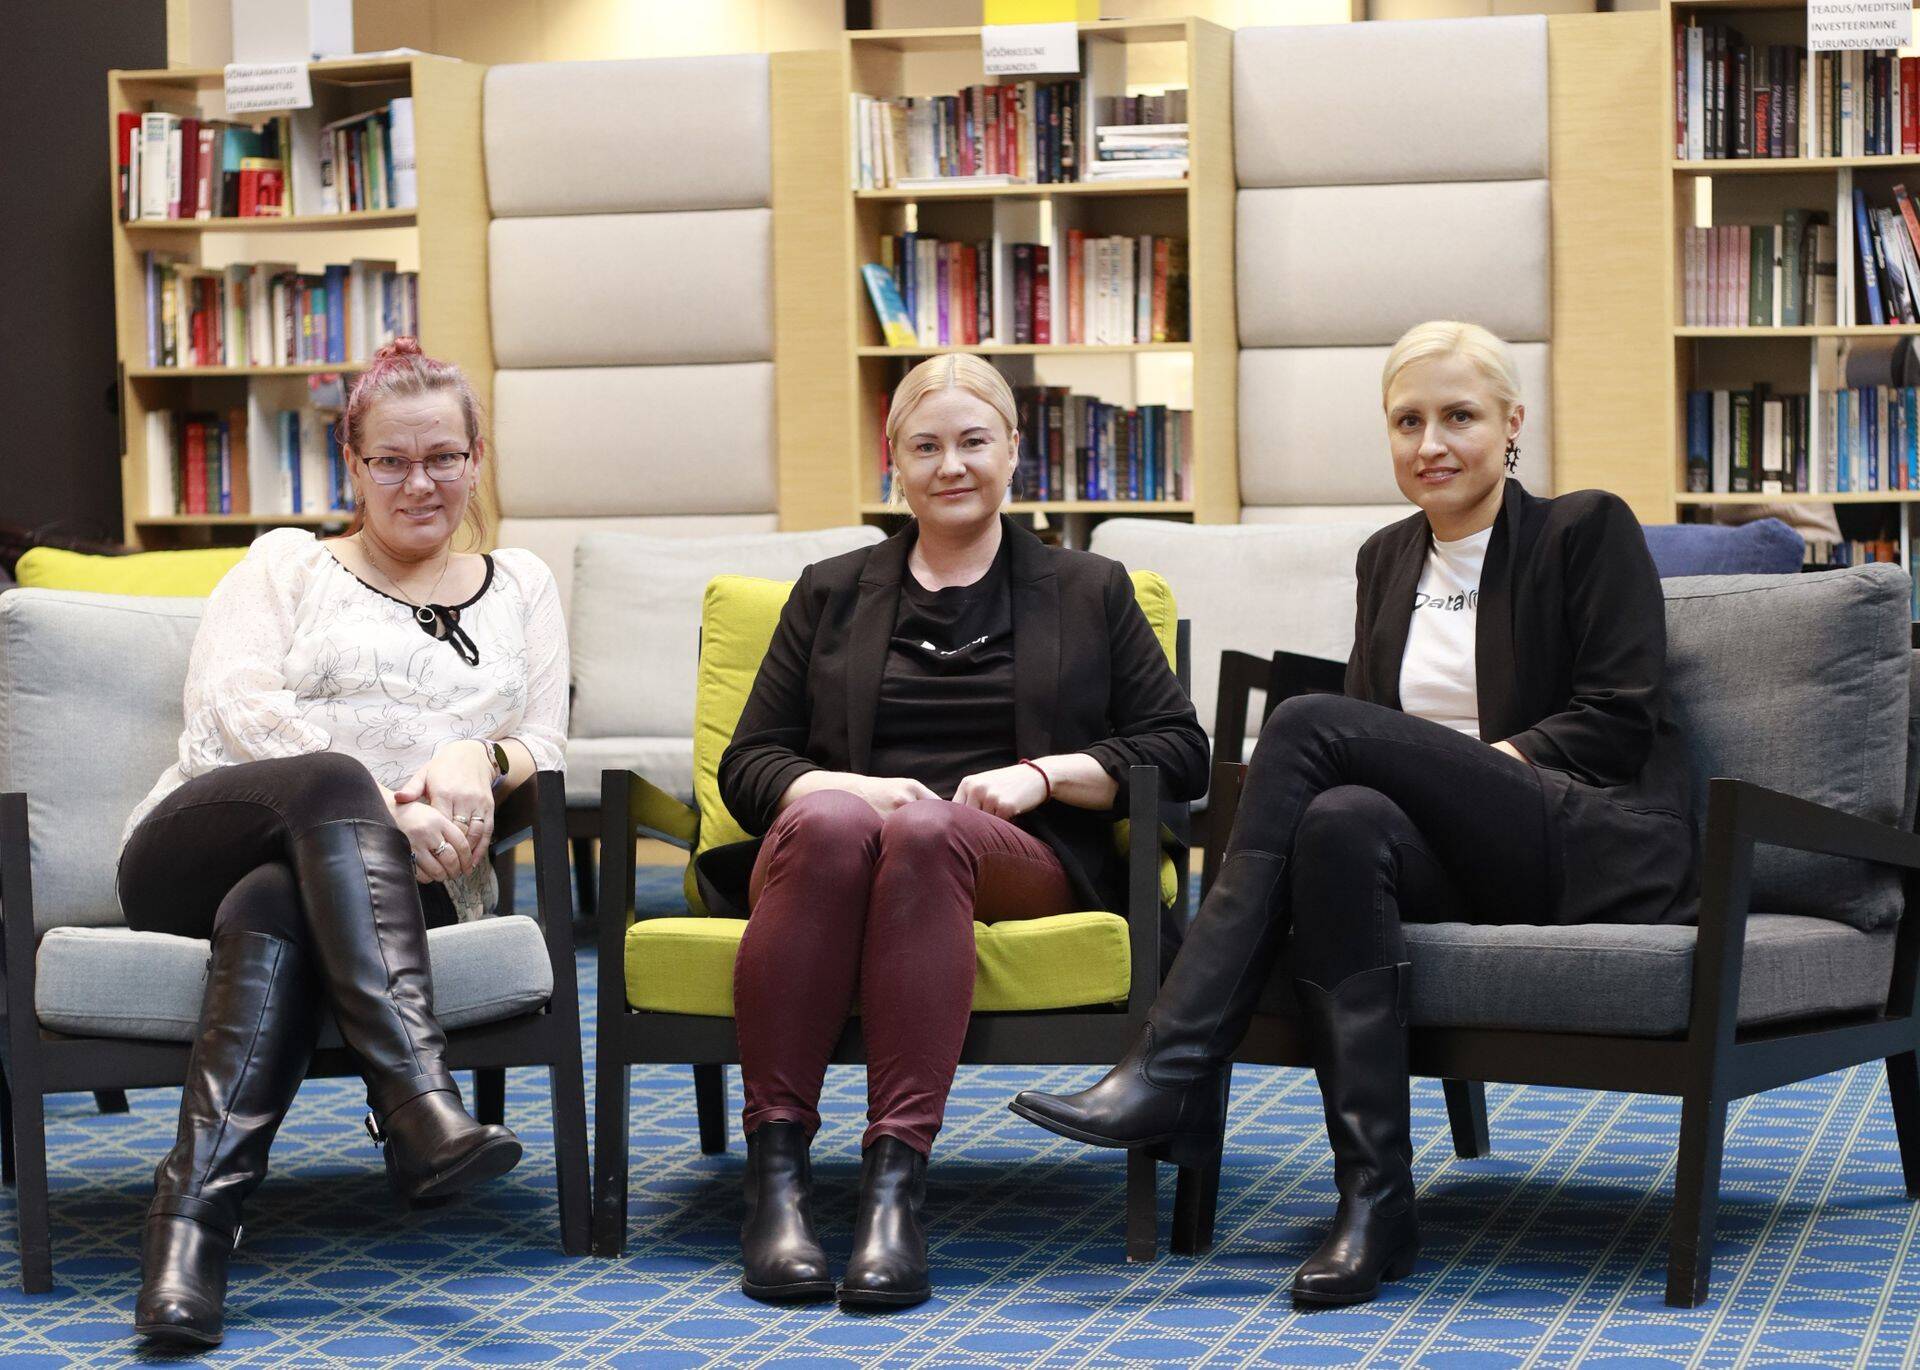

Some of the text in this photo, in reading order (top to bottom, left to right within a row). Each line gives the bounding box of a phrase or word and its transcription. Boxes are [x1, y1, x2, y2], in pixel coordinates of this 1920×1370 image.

[1811, 2, 1911, 14] TEADUS/MEDITSIIN
[1811, 20, 1897, 31] INVESTEERIMINE
[1811, 36, 1908, 48] TURUNDUS/MÜÜK
